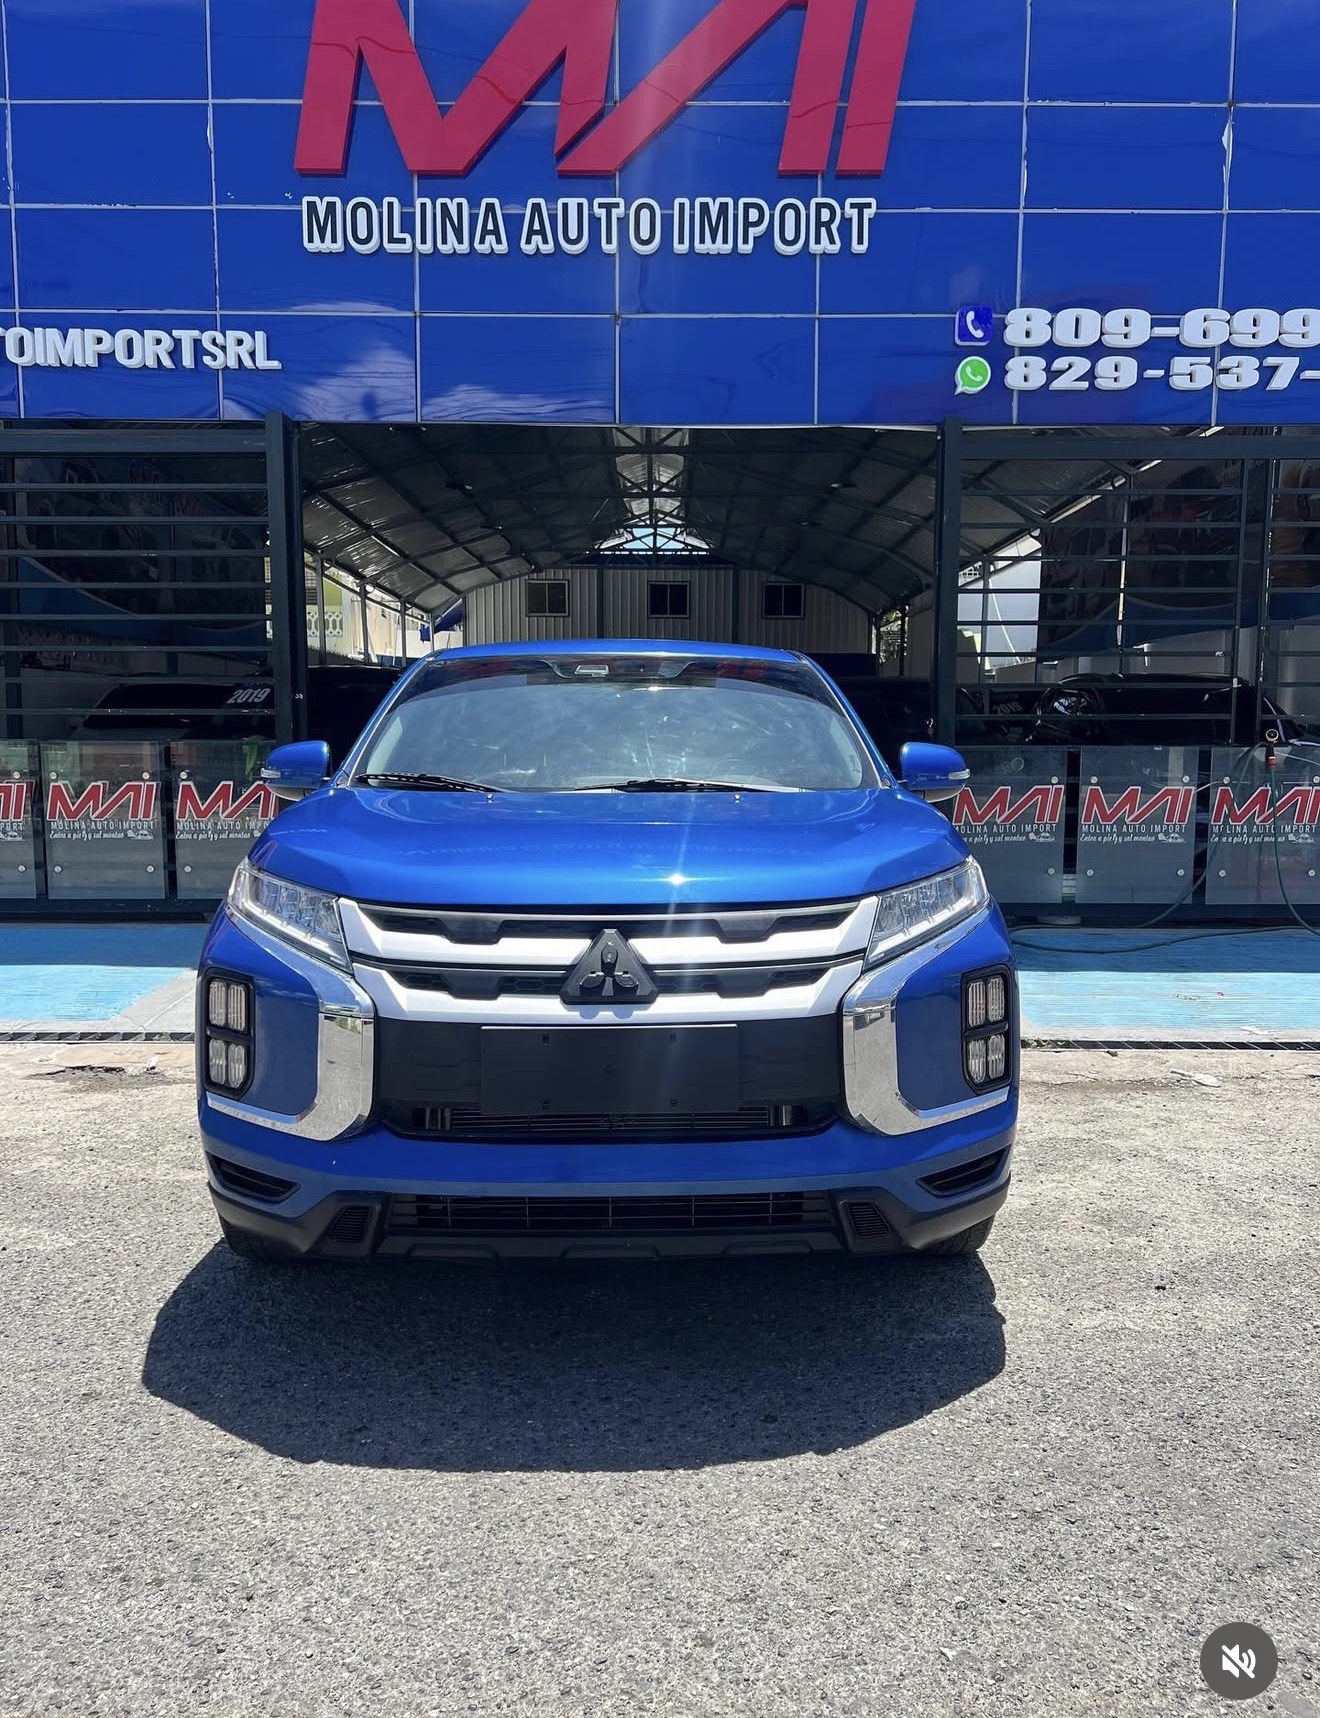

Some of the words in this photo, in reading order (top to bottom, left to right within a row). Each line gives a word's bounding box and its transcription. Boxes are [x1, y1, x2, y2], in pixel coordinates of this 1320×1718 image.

[301, 196, 507, 254] MOLINA
[519, 197, 662, 255] AUTO
[672, 197, 877, 255] IMPORT
[0, 326, 282, 370] OIMPORTSRL
[226, 688, 271, 704] 2019
[47, 781, 156, 821] MAI
[952, 785, 1064, 825] MAI
[1081, 786, 1194, 824] MAI
[50, 821, 86, 831] MOLINA
[91, 821, 115, 830] AUTO
[119, 821, 154, 830] IMPORT
[176, 821, 212, 831] MOLINA
[216, 821, 241, 830] AUTO
[992, 824, 1017, 833] AUTO
[1021, 823, 1057, 832] IMPORT
[1081, 825, 1118, 833] MOLINA
[1122, 824, 1146, 833] AUTO
[1150, 824, 1186, 833] IMPORT
[1281, 824, 1316, 833] IMPORT
